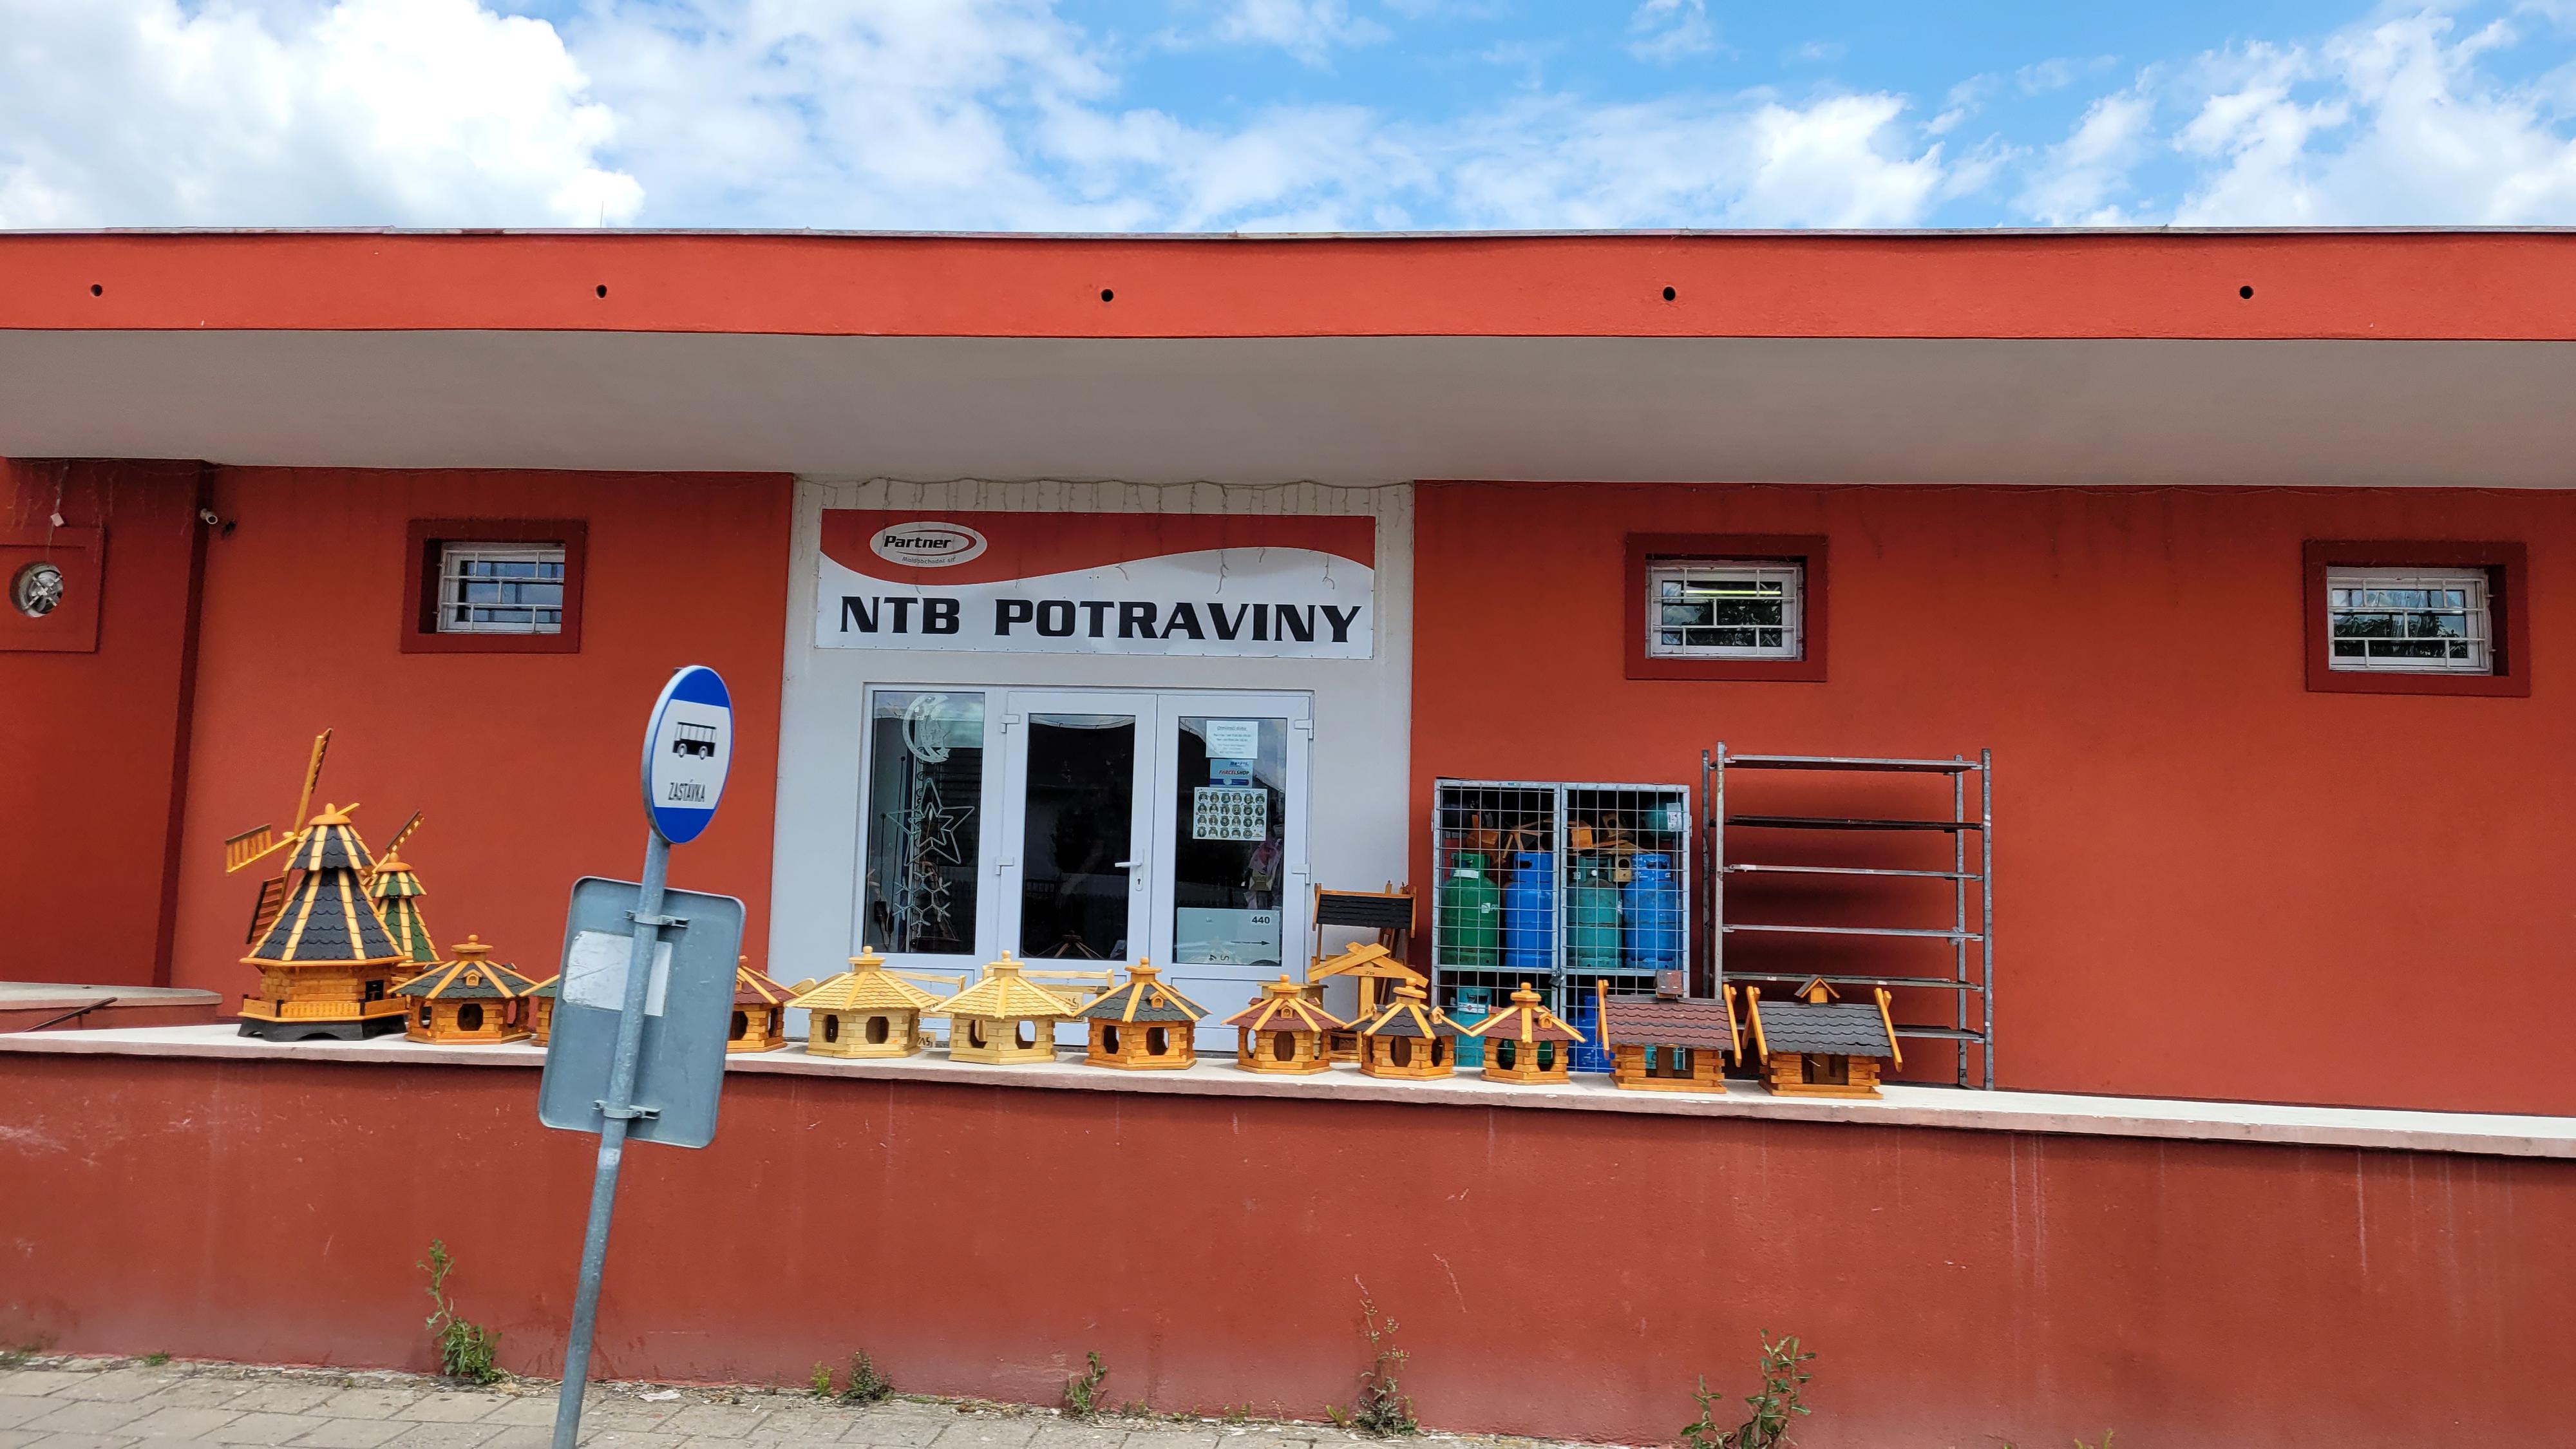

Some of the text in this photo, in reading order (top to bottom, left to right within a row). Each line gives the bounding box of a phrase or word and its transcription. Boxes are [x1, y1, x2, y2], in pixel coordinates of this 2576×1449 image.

[884, 536, 951, 548] Partner
[840, 596, 1362, 643] NTB POTRAVINY
[668, 779, 706, 802] ZASTÁVKA
[1251, 916, 1270, 924] 440
